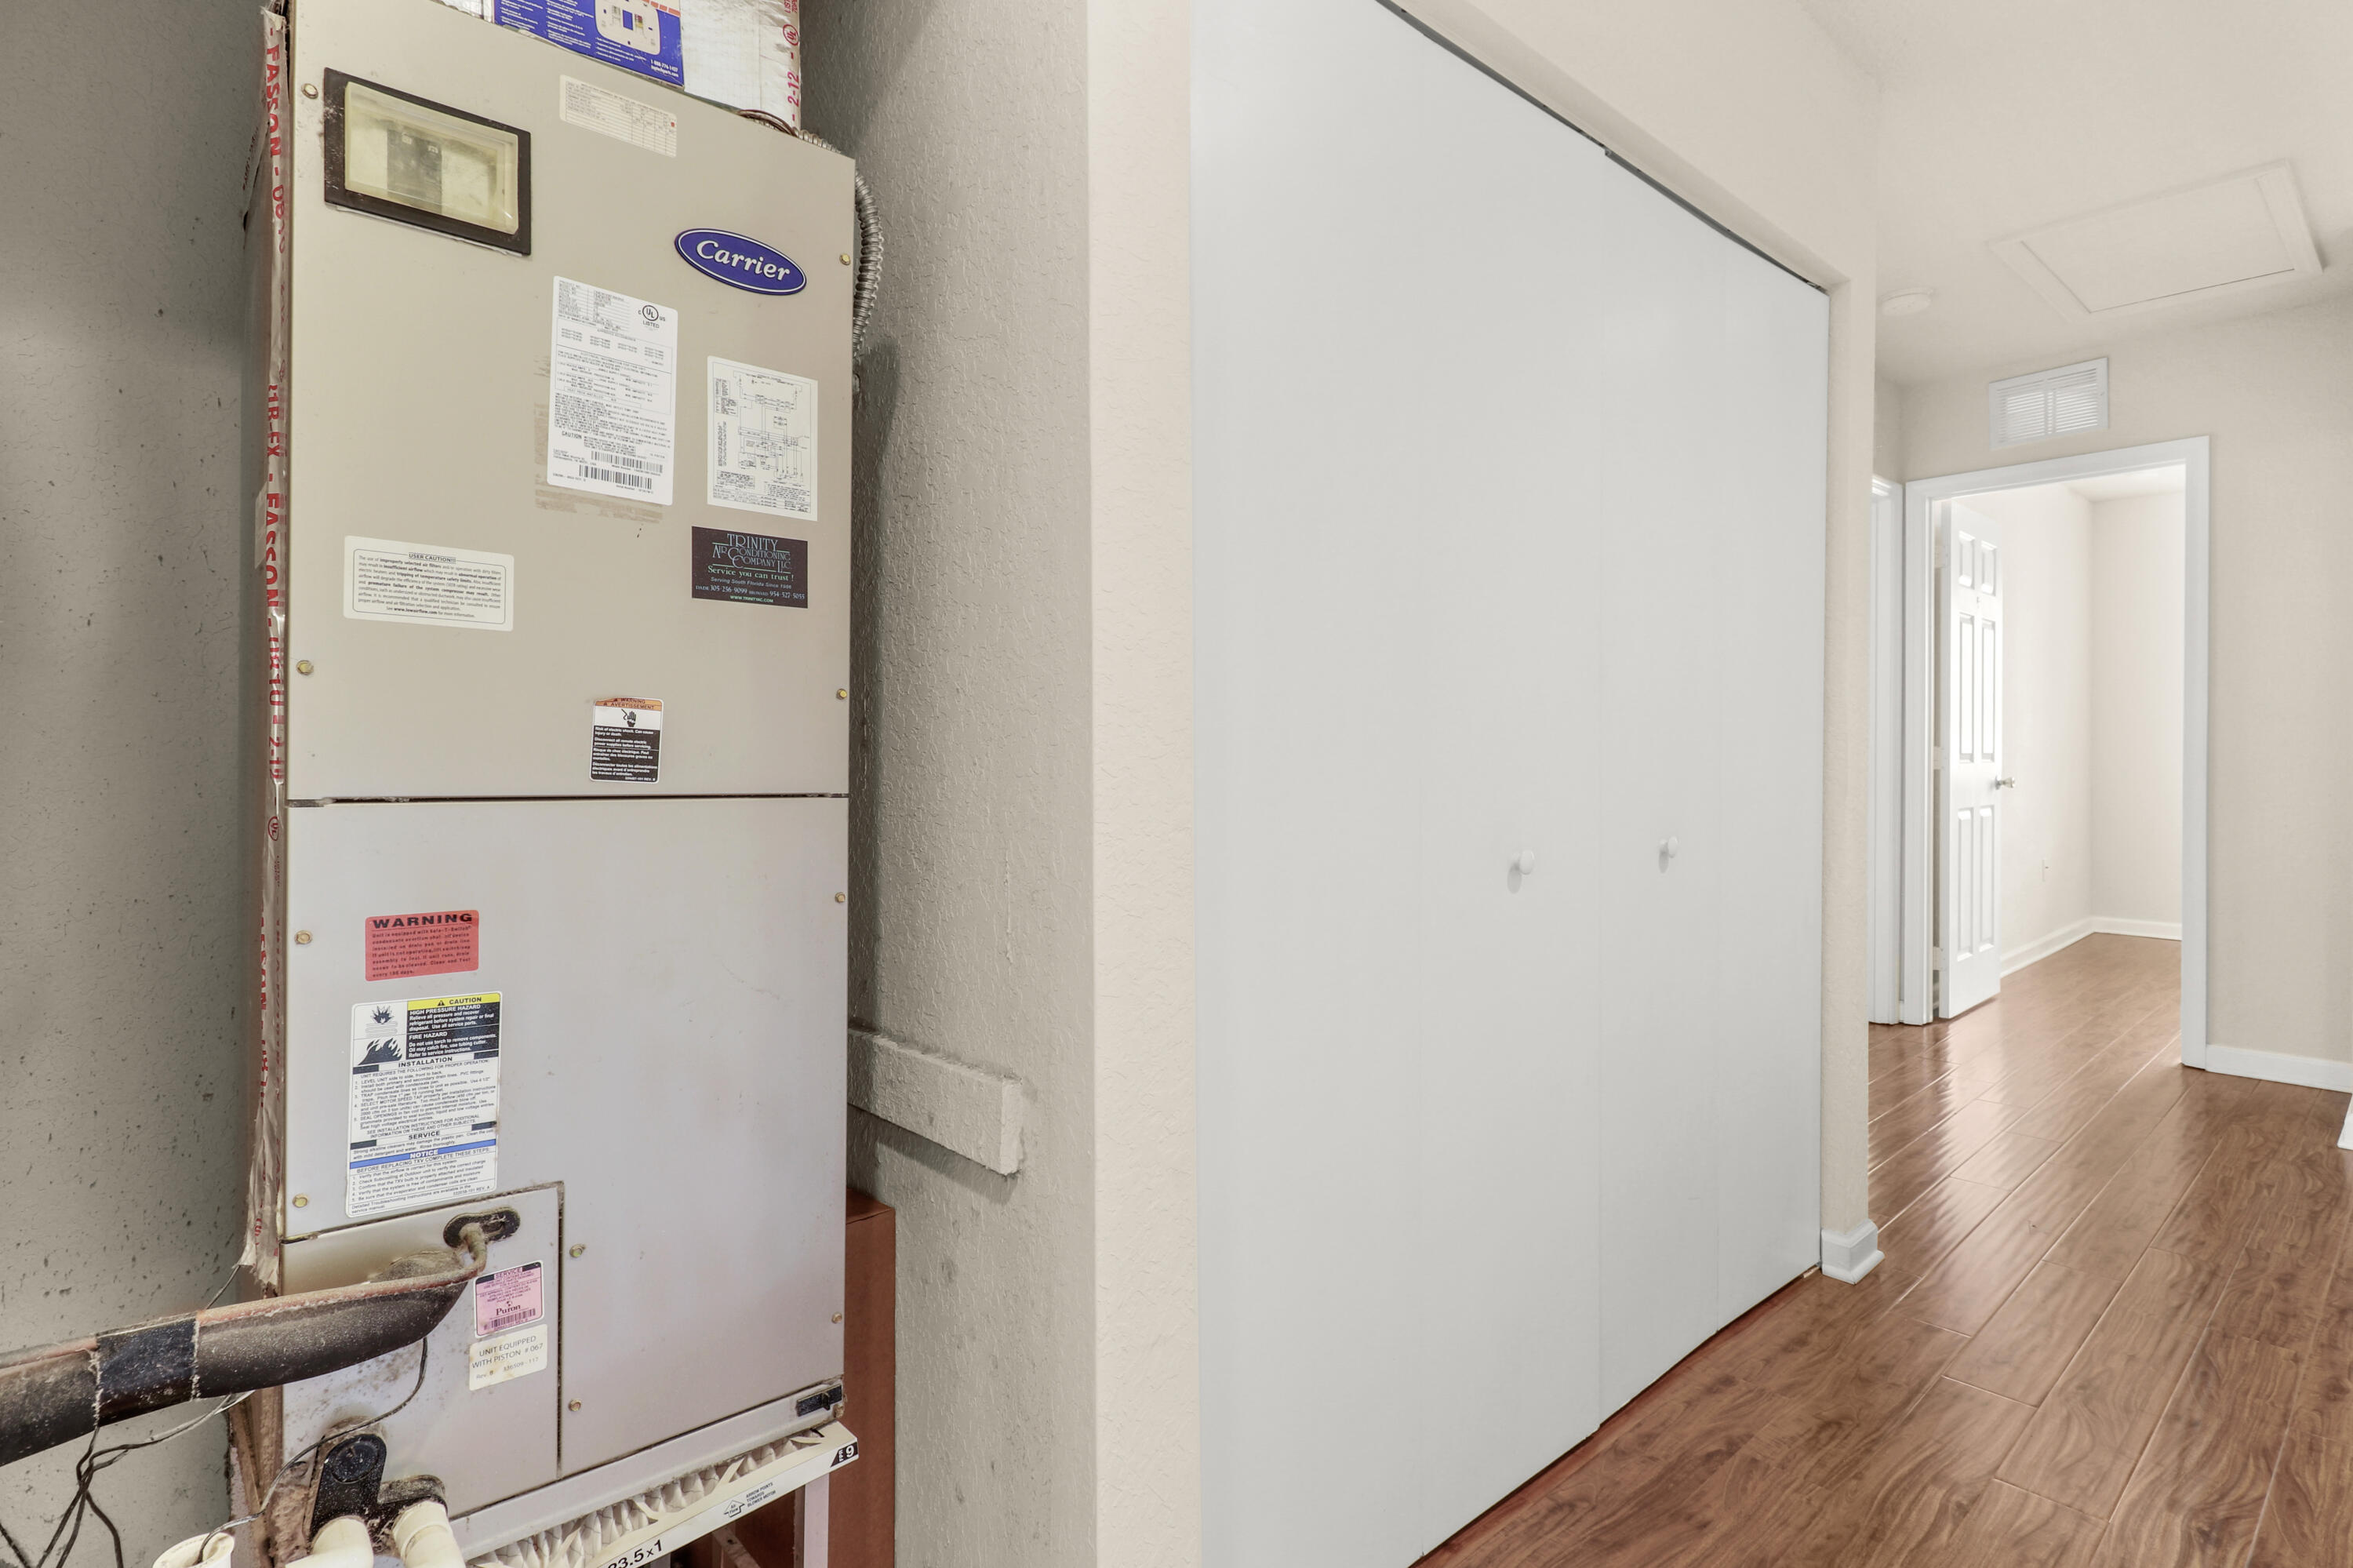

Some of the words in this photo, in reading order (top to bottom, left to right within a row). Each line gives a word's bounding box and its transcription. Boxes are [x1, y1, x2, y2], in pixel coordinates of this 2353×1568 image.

[787, 71, 799, 107] 2-12
[696, 239, 791, 281] Carrier
[642, 320, 660, 329] LISTED
[562, 431, 582, 440] CAUTION
[727, 533, 778, 551] TRINITY
[712, 544, 727, 559] AIR
[728, 546, 791, 566] CONDITIONING
[732, 555, 776, 572] COMPANY
[707, 565, 736, 575] Service
[739, 569, 751, 579] you
[373, 913, 472, 929] WARNING
[398, 1057, 452, 1067] INSTALLATION
[376, 1124, 409, 1133] INSTALLATION
[410, 1119, 442, 1128] INSTRUCTIONS
[408, 1130, 439, 1140] SERVICE
[380, 1159, 412, 1169] REPLACING
[424, 1153, 453, 1162] COMPLETE
[409, 1149, 438, 1159] NOTICE
[495, 1267, 522, 1279] SERVICE
[496, 1304, 521, 1315] Puron
[479, 1346, 496, 1356] UNIT
[499, 1336, 536, 1351] EQUIPPED
[471, 1358, 493, 1368] WITH
[493, 1349, 521, 1362] PISTON
[846, 1445, 854, 1457] 9
[746, 1489, 759, 1498] ARROW
[759, 1482, 773, 1493] POINTS
[747, 1492, 765, 1503] TOWARDS
[747, 1497, 763, 1508] BLOWER
[763, 1490, 776, 1500] MOTOR
